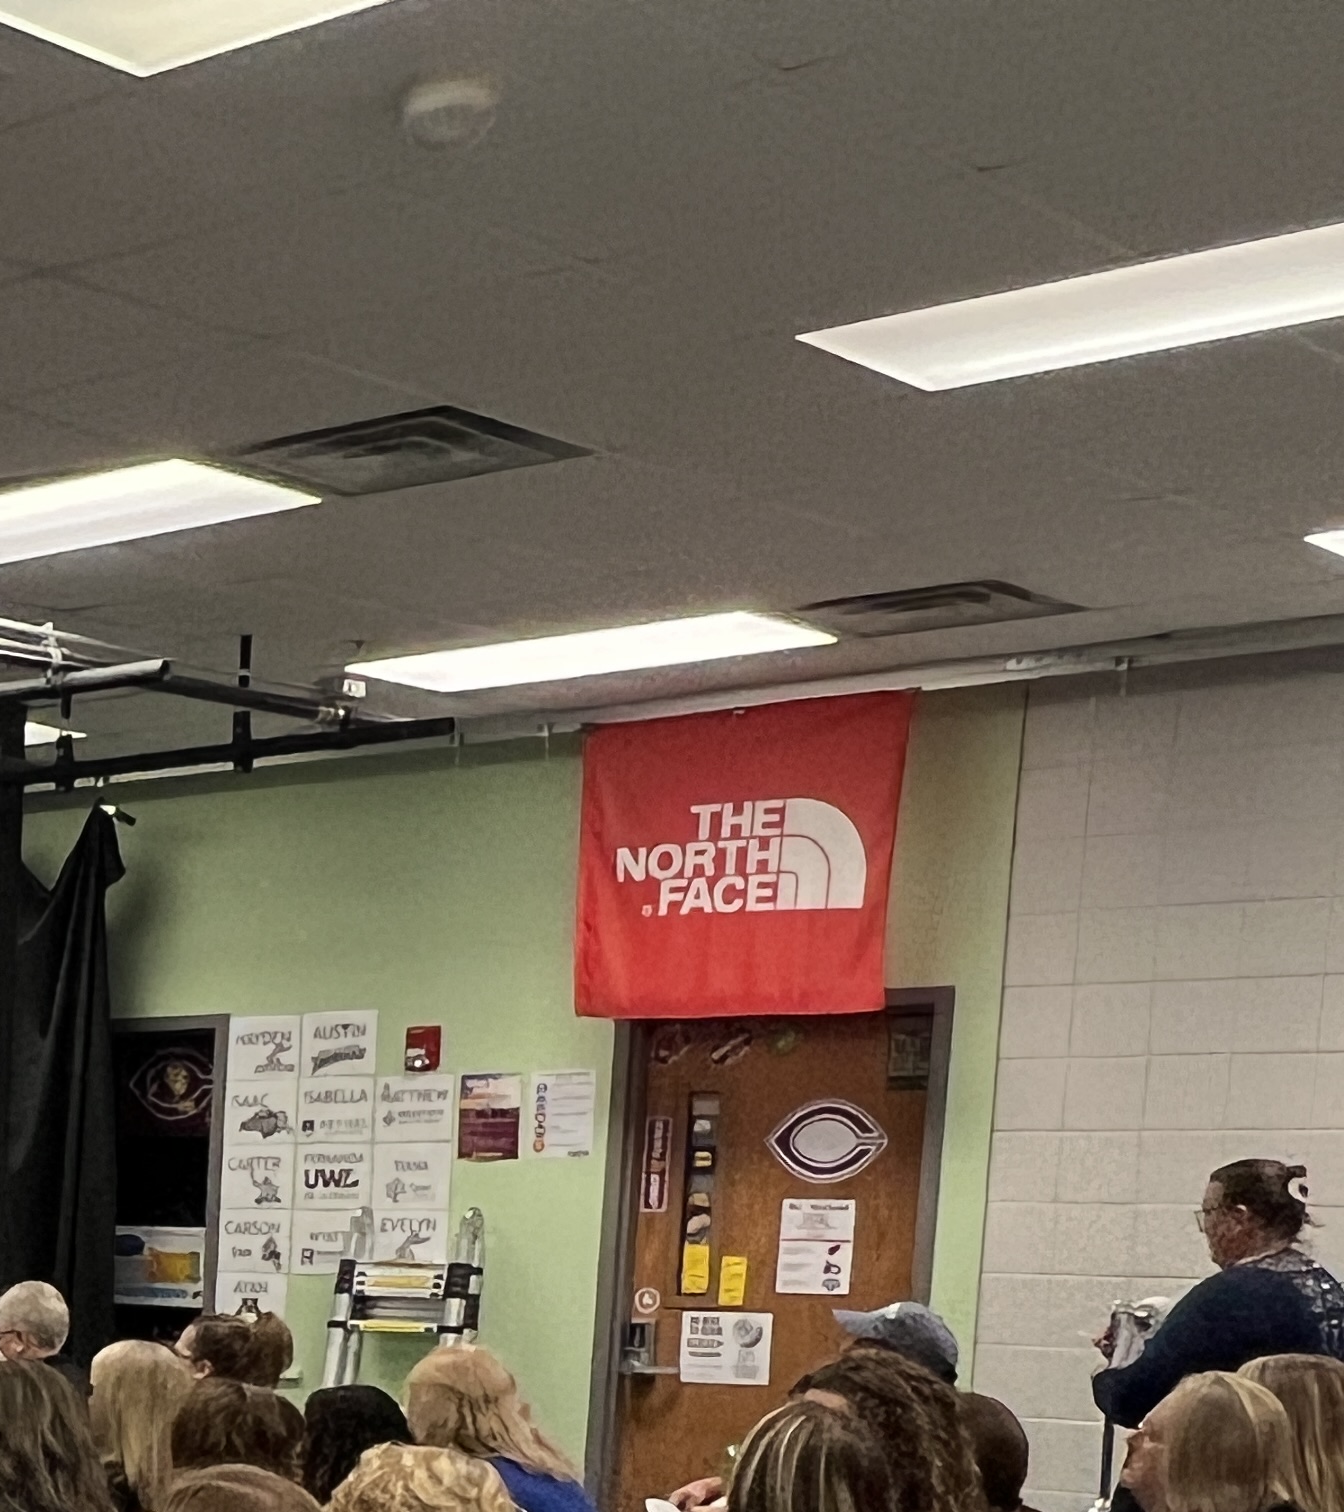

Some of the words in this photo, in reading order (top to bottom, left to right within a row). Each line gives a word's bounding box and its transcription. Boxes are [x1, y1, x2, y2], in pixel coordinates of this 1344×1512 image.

[690, 800, 785, 840] THE
[616, 837, 780, 882] NORTH
[658, 873, 778, 916] FACE
